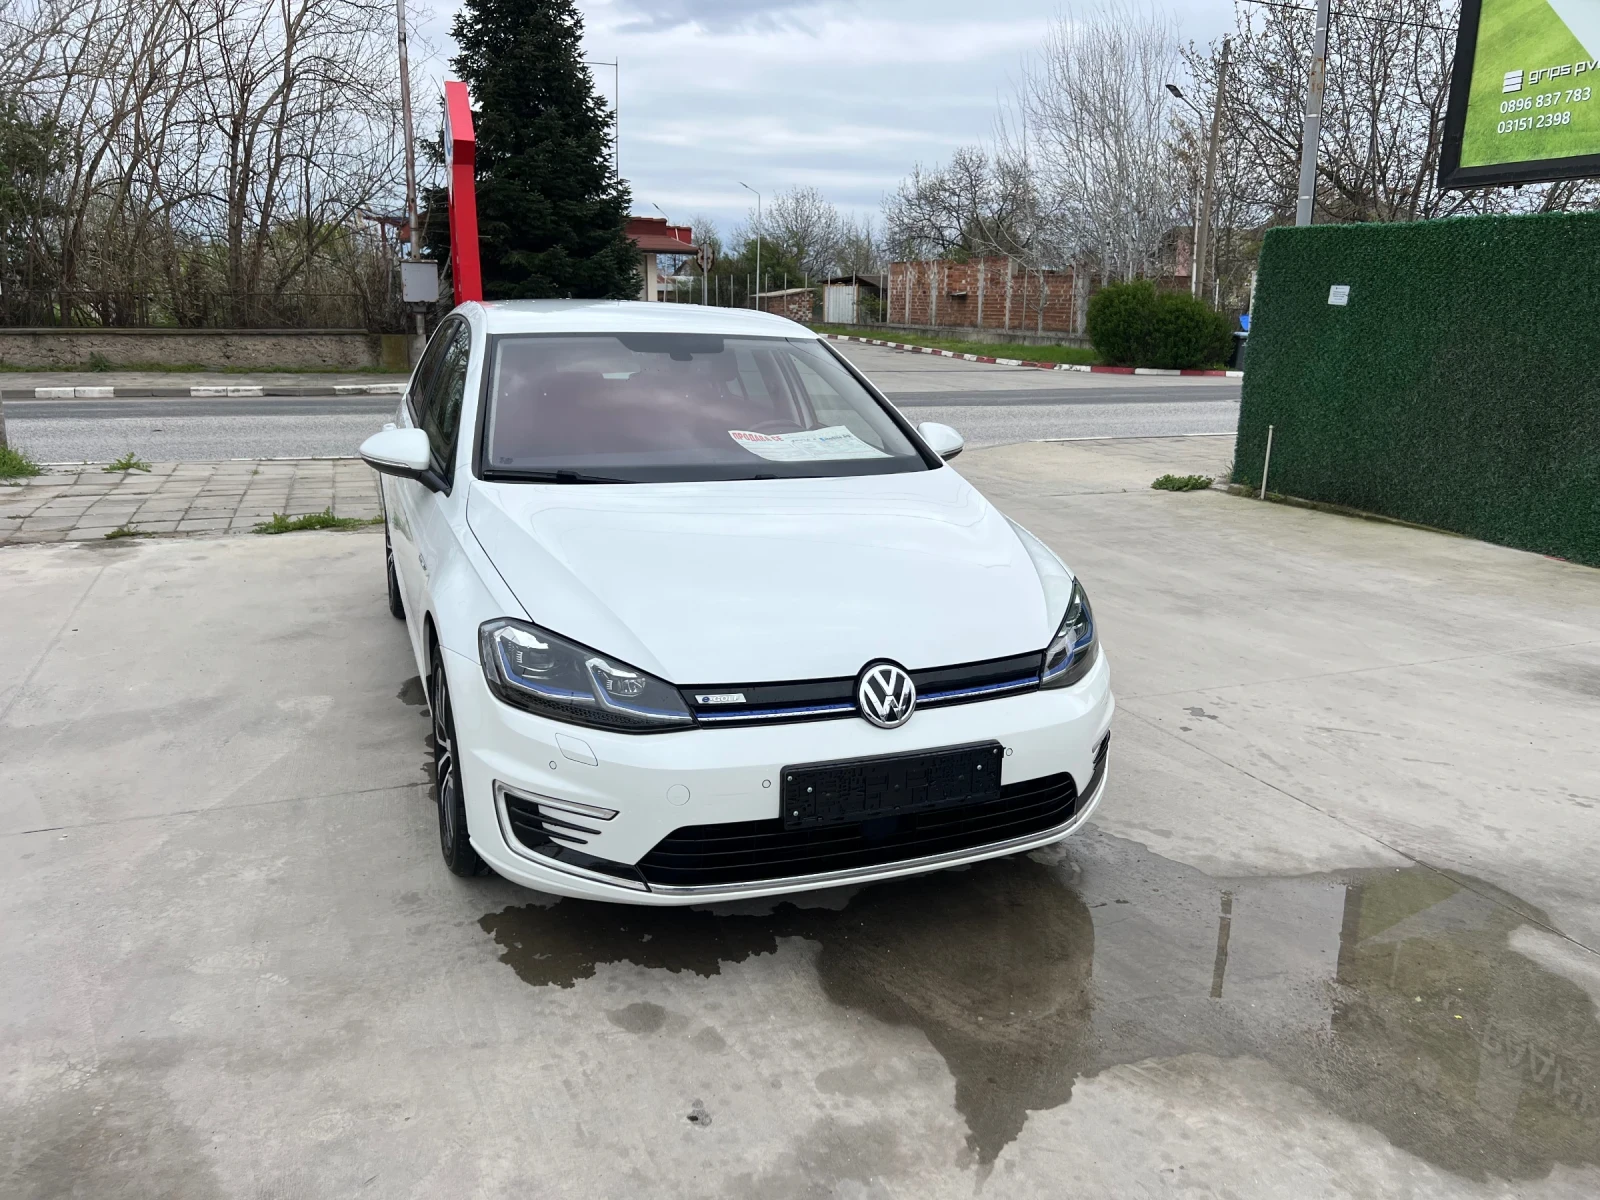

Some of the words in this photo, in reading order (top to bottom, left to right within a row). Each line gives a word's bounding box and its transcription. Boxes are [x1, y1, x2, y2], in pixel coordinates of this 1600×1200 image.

[1528, 64, 1572, 85] grips
[1574, 60, 1600, 76] pv
[1500, 97, 1532, 114] 0896
[1536, 91, 1561, 108] 837
[1565, 87, 1591, 103] 783
[1497, 117, 1533, 134] 03151
[1536, 111, 1571, 128] 2398
[732, 432, 770, 442] ПРОДАВА
